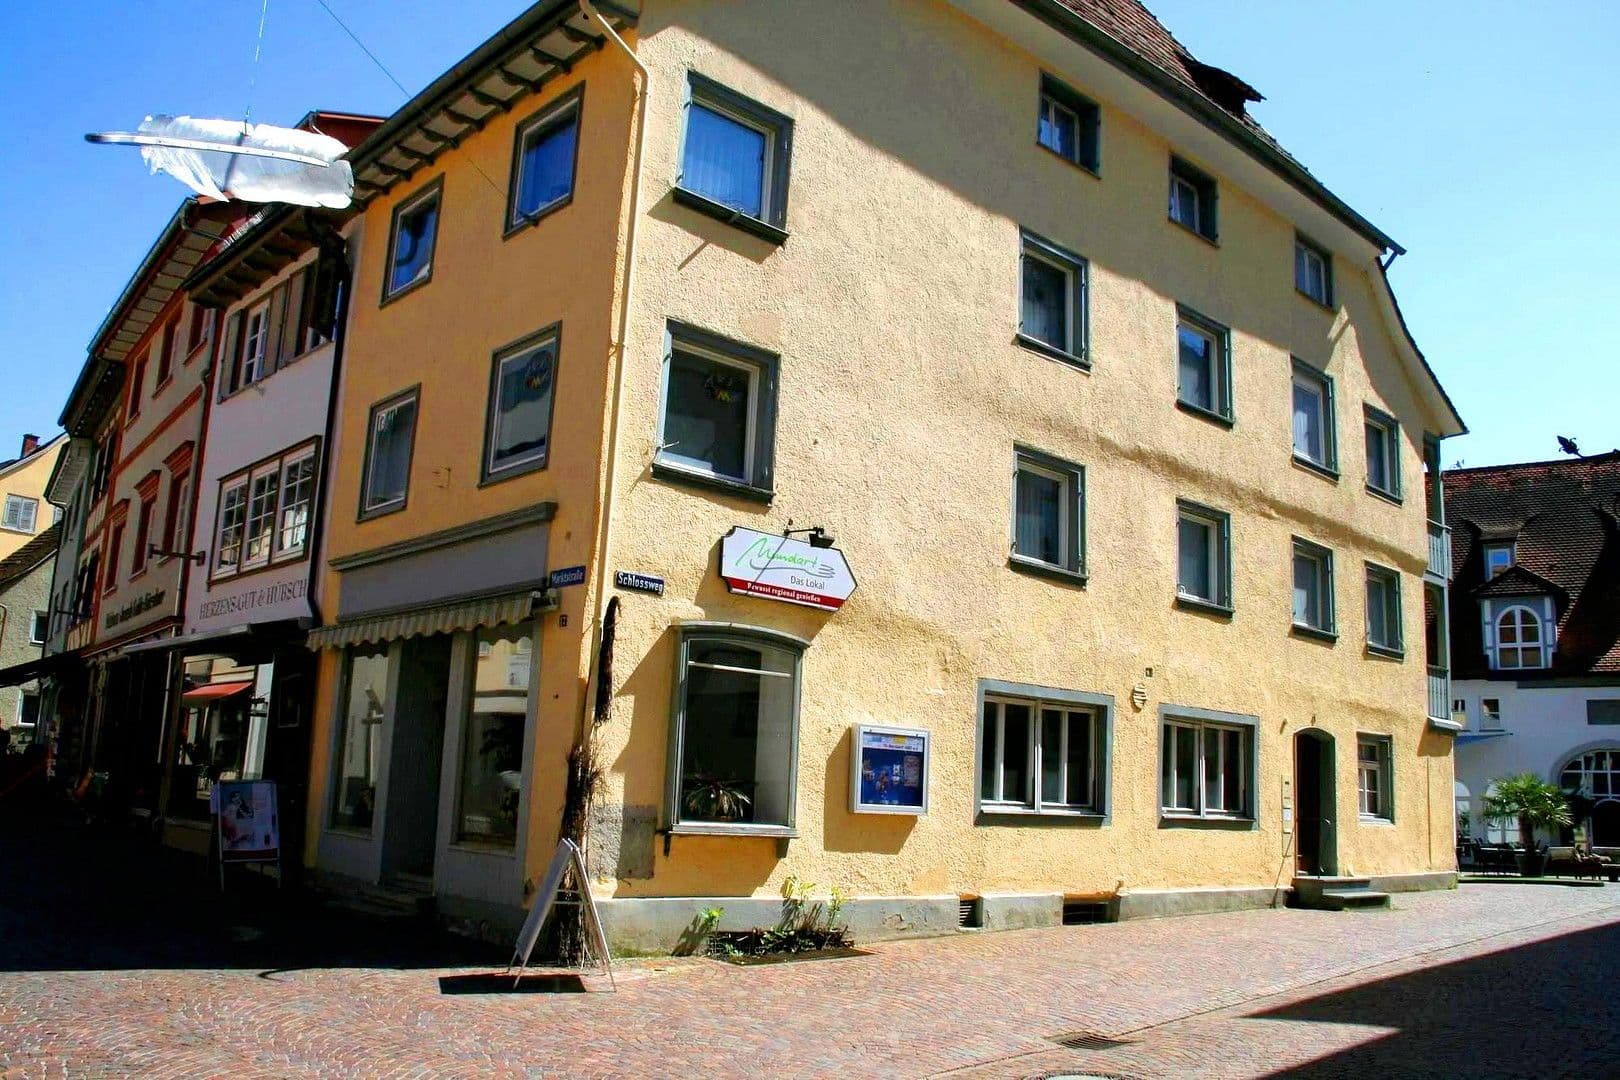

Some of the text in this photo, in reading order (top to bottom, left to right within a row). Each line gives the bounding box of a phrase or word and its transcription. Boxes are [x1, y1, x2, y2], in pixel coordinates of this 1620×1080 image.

[735, 537, 818, 567] Mundart
[266, 578, 308, 605] HÜBSCH
[618, 572, 663, 595] Schlossweg
[790, 575, 825, 590] Das Lokal
[771, 588, 796, 598] regional
[796, 593, 821, 602] genießen
